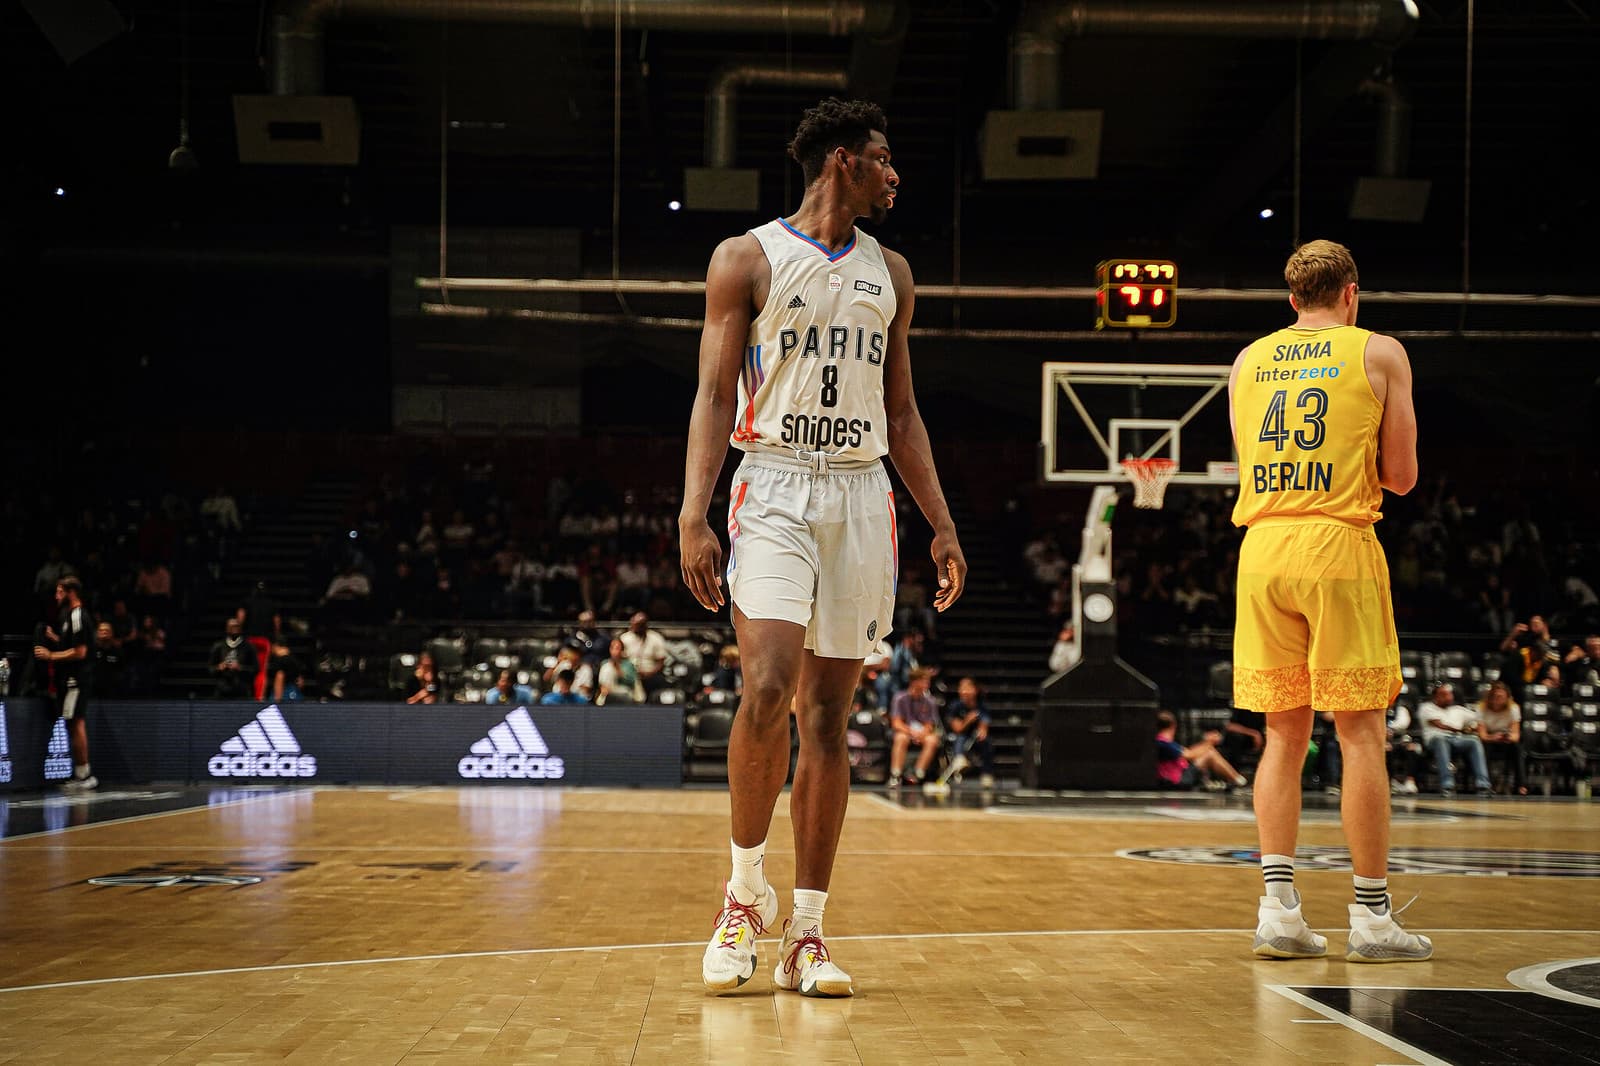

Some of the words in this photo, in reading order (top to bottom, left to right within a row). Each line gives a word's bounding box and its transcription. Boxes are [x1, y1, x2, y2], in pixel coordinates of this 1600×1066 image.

[779, 325, 884, 367] PARIS
[1273, 341, 1332, 362] SIKMA
[820, 364, 838, 408] 8
[781, 413, 863, 451] snipes
[1258, 387, 1329, 452] 43
[1253, 461, 1333, 494] BERLIN
[207, 751, 318, 778] adidas
[457, 752, 565, 779] adidas
